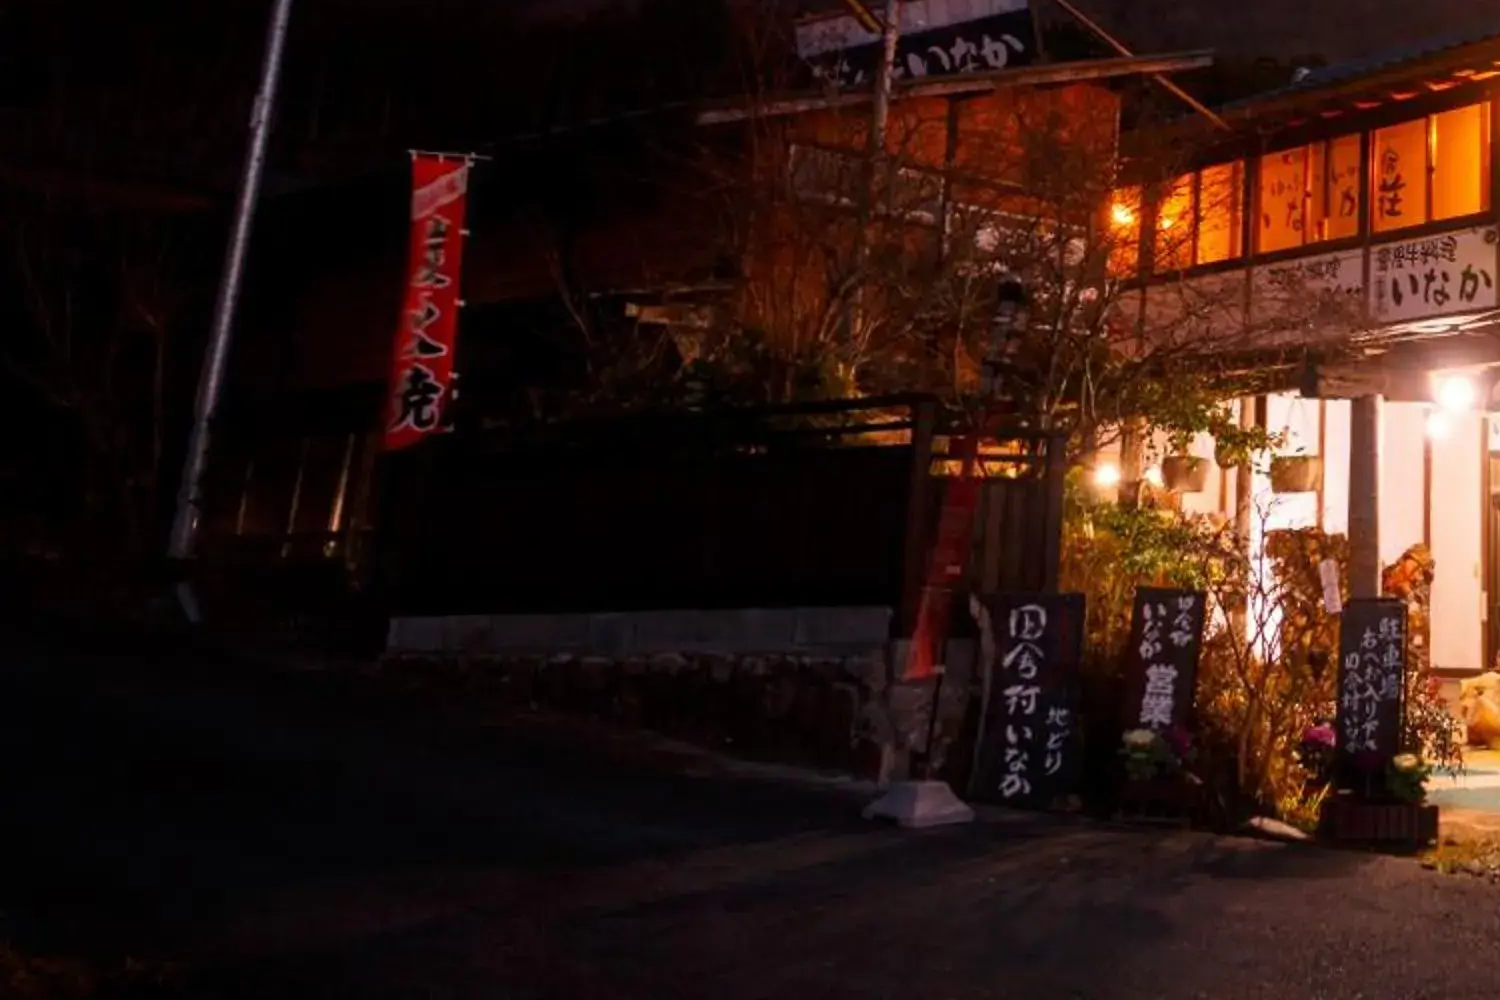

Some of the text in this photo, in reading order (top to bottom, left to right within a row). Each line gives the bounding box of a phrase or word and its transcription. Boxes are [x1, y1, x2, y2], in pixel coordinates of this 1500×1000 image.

[1392, 264, 1492, 307] いなか
[1045, 706, 1070, 775] 地どり
